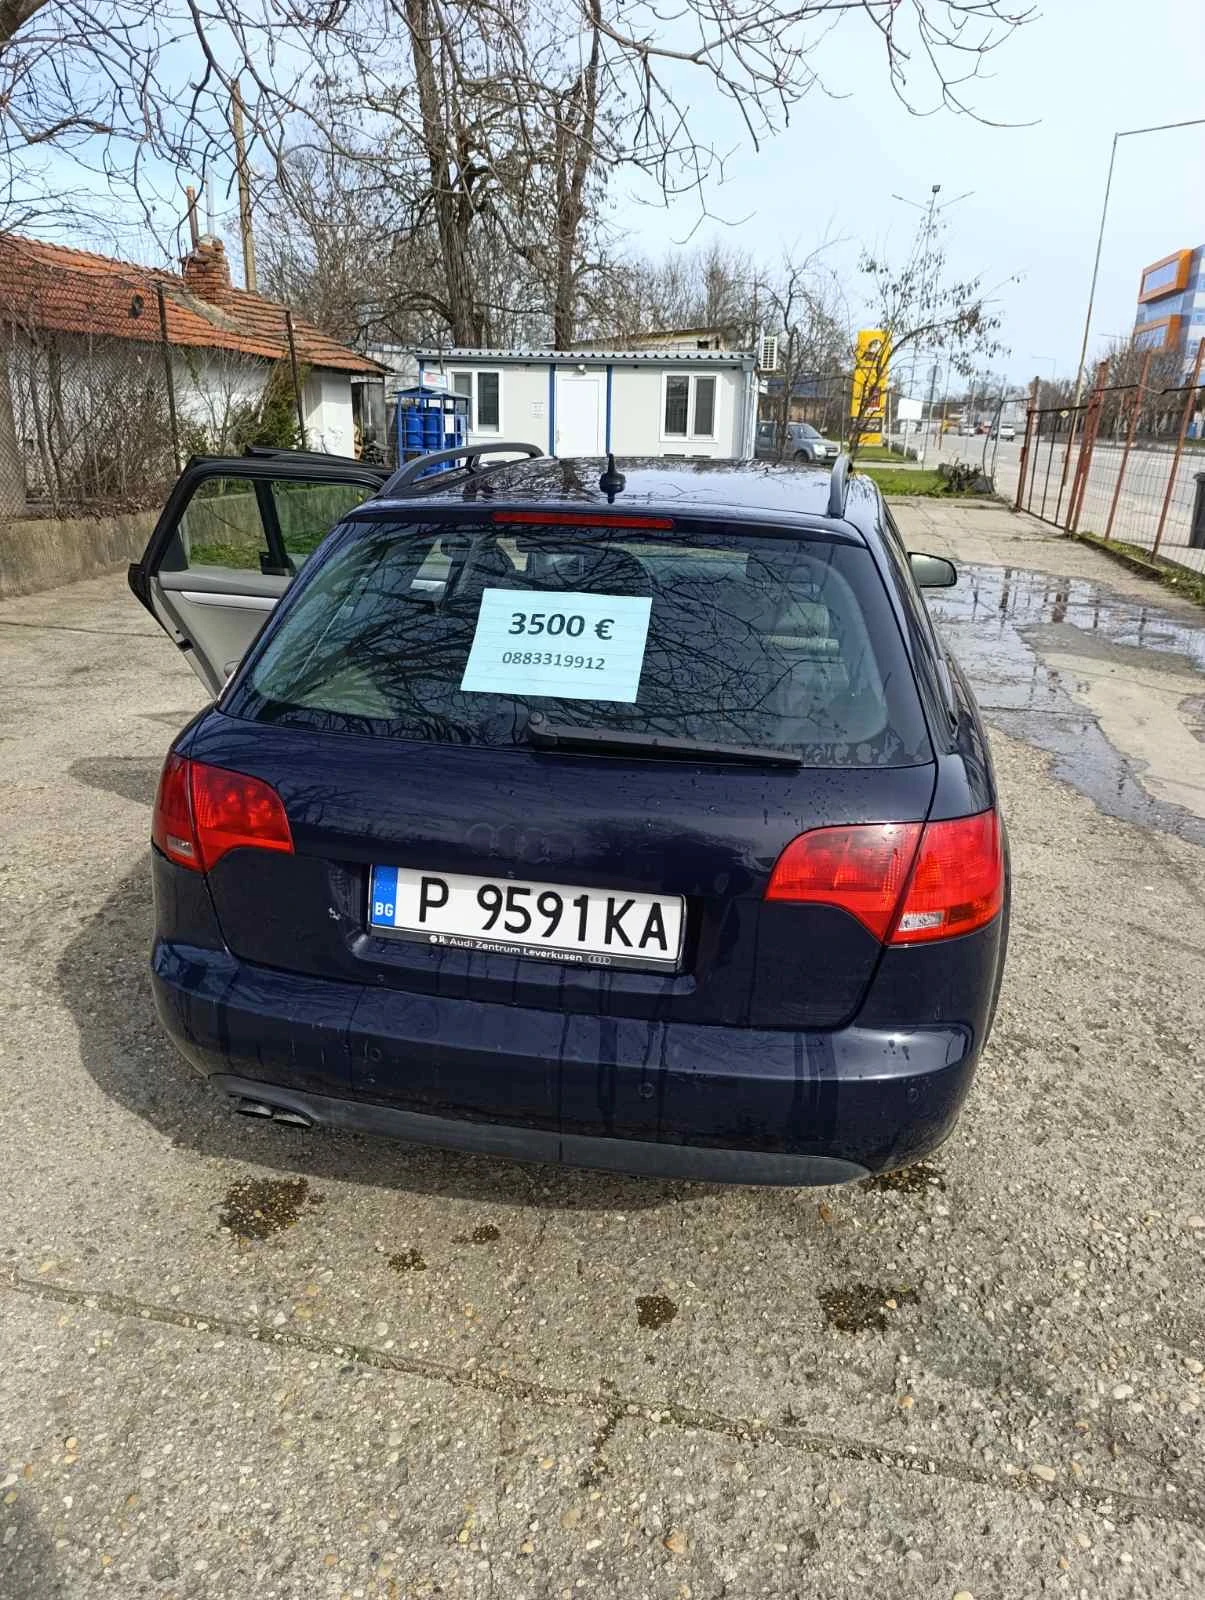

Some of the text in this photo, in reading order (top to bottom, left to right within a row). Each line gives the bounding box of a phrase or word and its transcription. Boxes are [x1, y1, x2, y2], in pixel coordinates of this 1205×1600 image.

[508, 612, 615, 640] 3500 €
[502, 651, 605, 670] 0883319912
[375, 901, 394, 917] BG
[419, 876, 449, 923] P
[450, 938, 473, 947] Audi
[476, 941, 521, 953] Zentrum
[523, 947, 583, 961] Leverkusen
